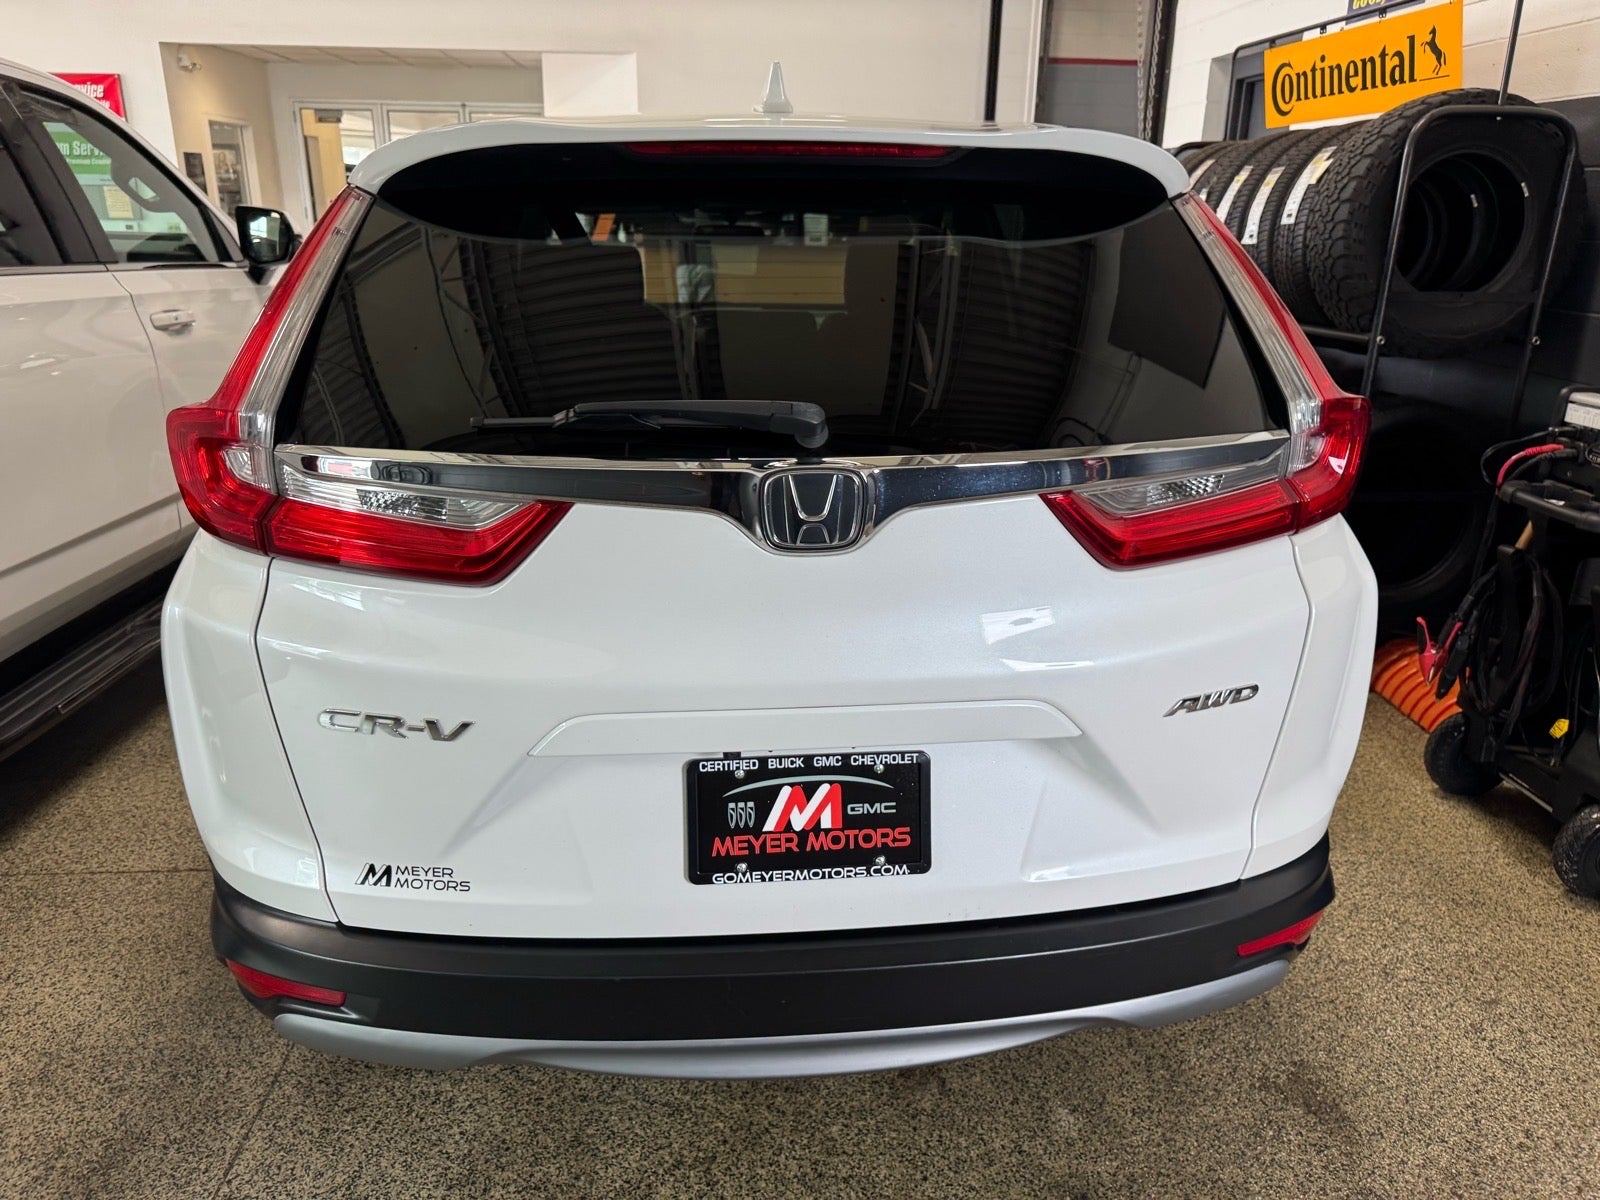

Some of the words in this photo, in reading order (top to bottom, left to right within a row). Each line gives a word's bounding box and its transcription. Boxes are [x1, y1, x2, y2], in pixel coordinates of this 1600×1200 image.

[1271, 34, 1418, 117] Continental
[1162, 684, 1259, 718] AWD
[318, 708, 476, 742] CR-V
[699, 759, 759, 772] CERTIFIED
[768, 757, 805, 769] BUICK
[813, 755, 842, 767] GMC
[850, 753, 919, 766] CHEVROLET
[847, 802, 897, 815] GMC
[712, 832, 799, 857] MEYER
[806, 827, 911, 851] MOTORS
[395, 865, 454, 878] MEYER
[712, 864, 909, 884] GOMEYERMOTORS.COM
[394, 878, 471, 892] MOTORS
